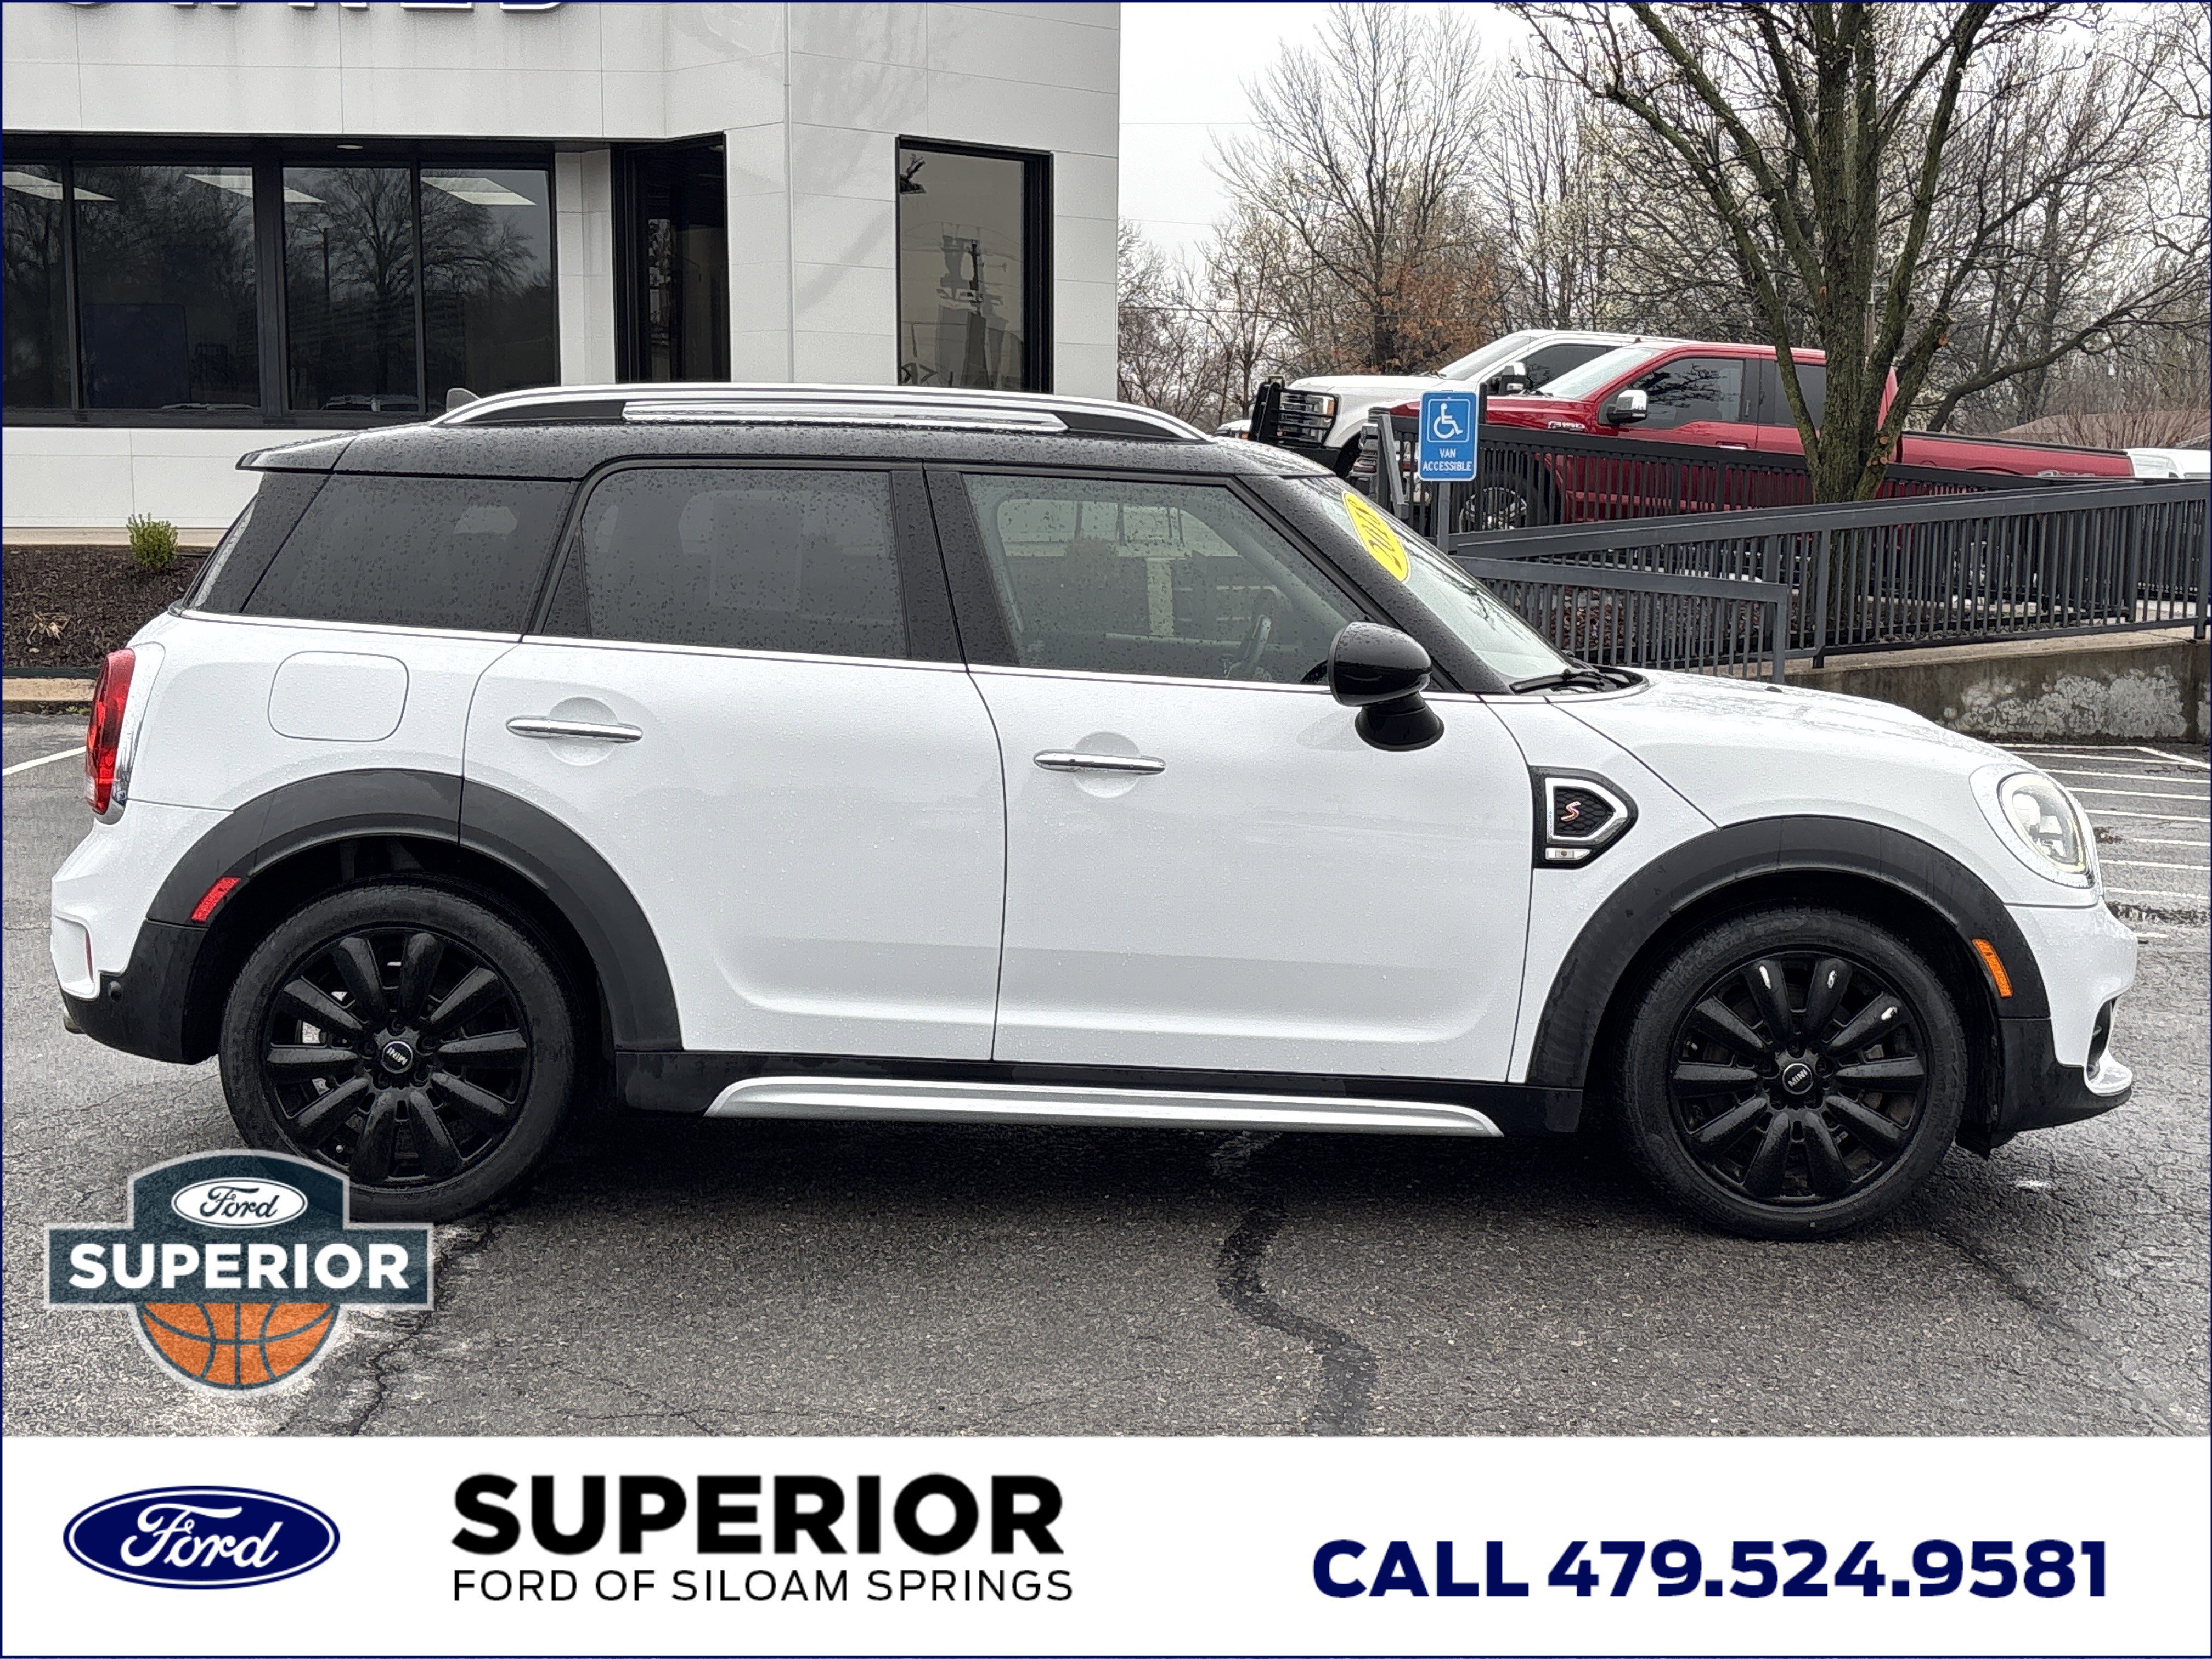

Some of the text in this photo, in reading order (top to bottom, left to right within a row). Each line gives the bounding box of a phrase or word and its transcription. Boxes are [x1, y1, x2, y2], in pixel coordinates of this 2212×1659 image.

[1439, 448, 1456, 458] VAN
[1423, 461, 1472, 471] ACCESSIBLE
[1561, 801, 1581, 822] S
[386, 1047, 408, 1065] MINI
[1787, 1069, 1808, 1087] MINI
